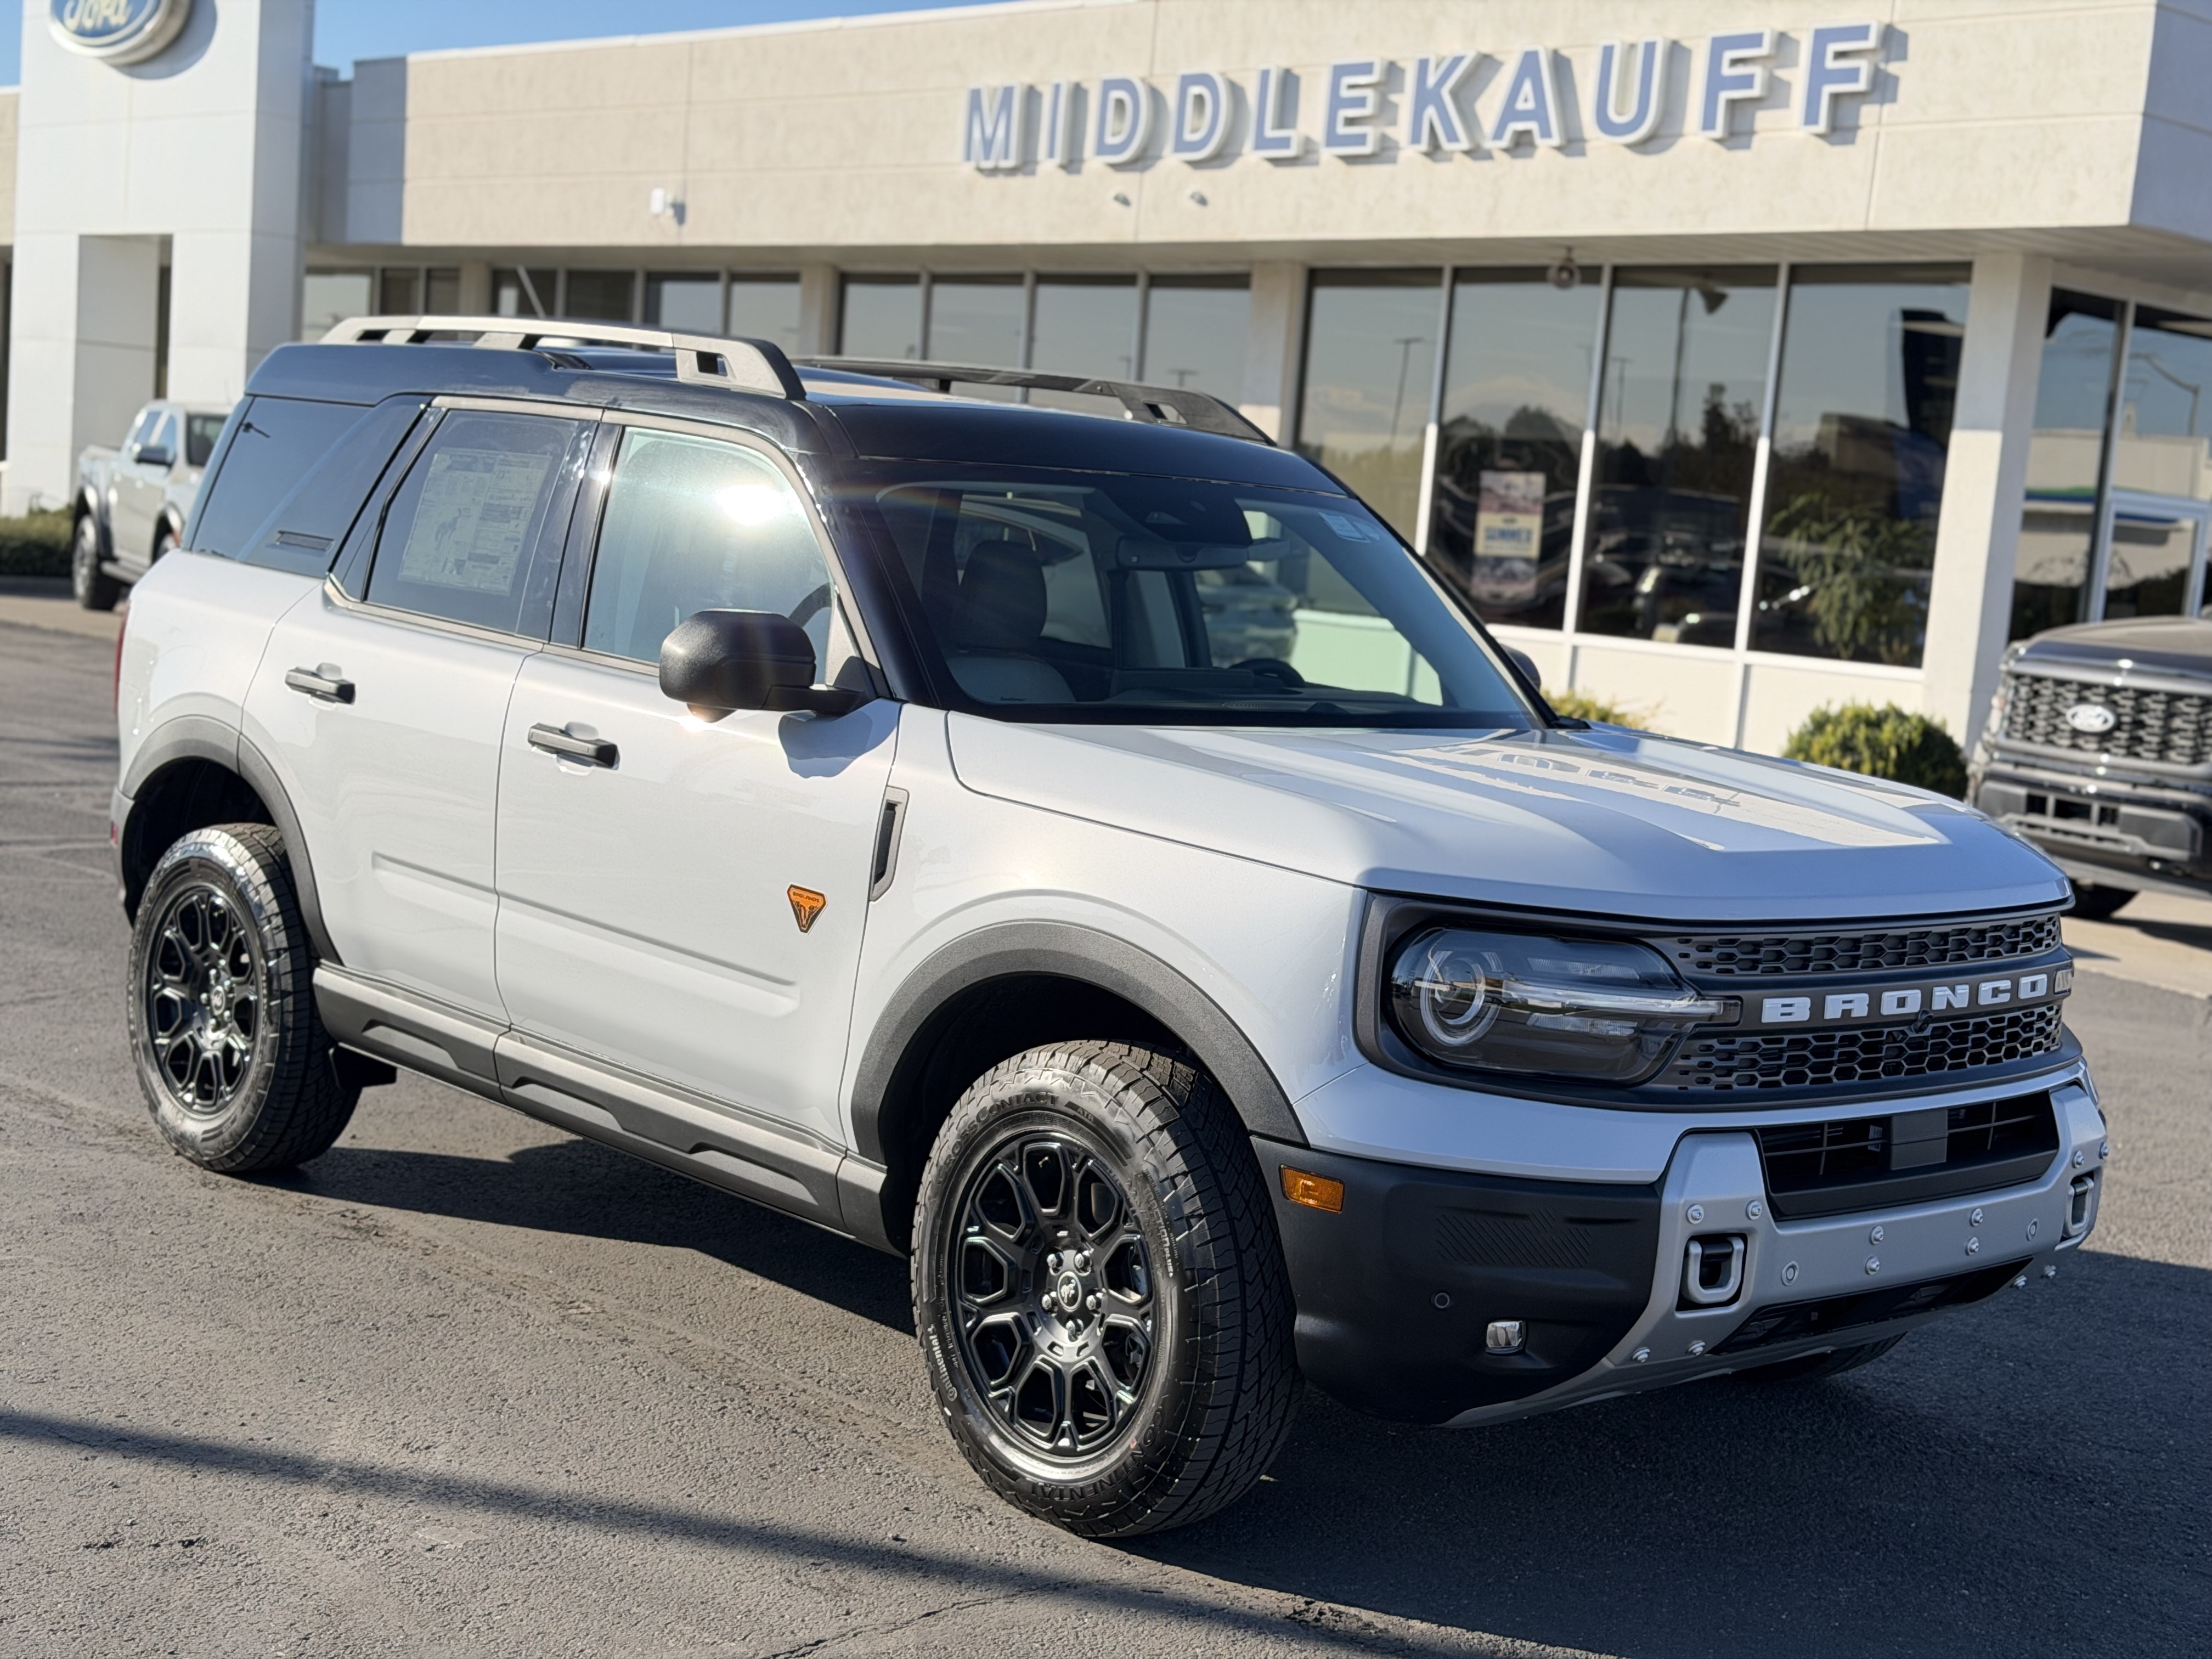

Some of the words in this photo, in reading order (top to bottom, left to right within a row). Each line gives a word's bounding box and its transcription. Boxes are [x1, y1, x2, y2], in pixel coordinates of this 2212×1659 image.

[964, 20, 1878, 169] MIDDLEKAUFF
[1760, 973, 2047, 1023] BRONCO
[1077, 1107, 1095, 1122] ATR
[929, 1334, 958, 1402] Continental
